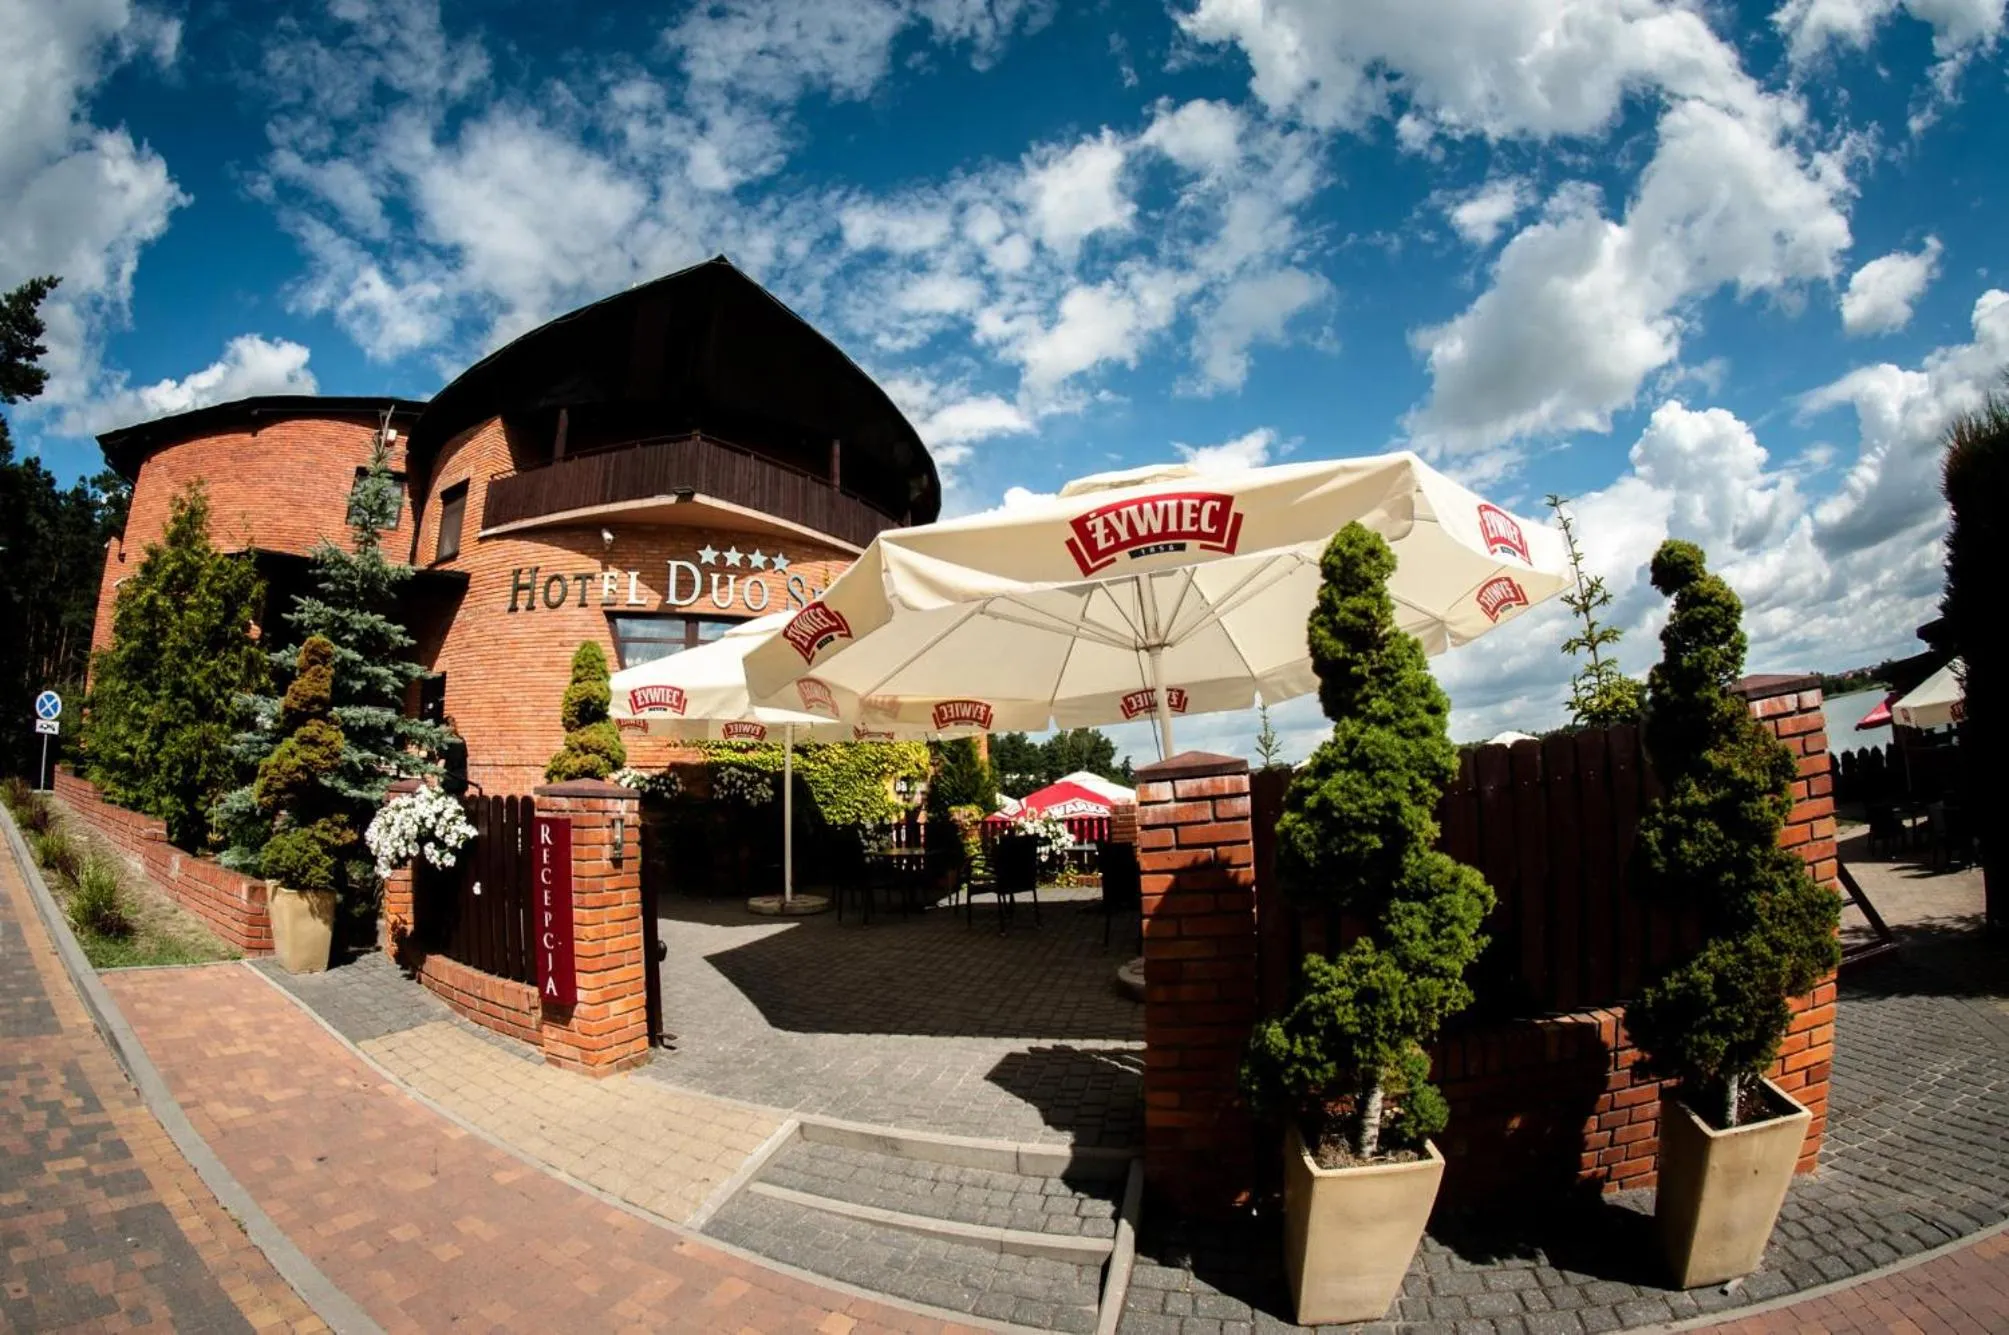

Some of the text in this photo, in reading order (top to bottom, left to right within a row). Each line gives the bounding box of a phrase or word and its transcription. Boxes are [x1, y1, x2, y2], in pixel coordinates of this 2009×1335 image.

[1086, 500, 1220, 550] ŻYWIEC
[667, 560, 770, 611] DUO
[634, 688, 680, 706] ŻYWIEC
[541, 823, 558, 997] RECEPCJA
